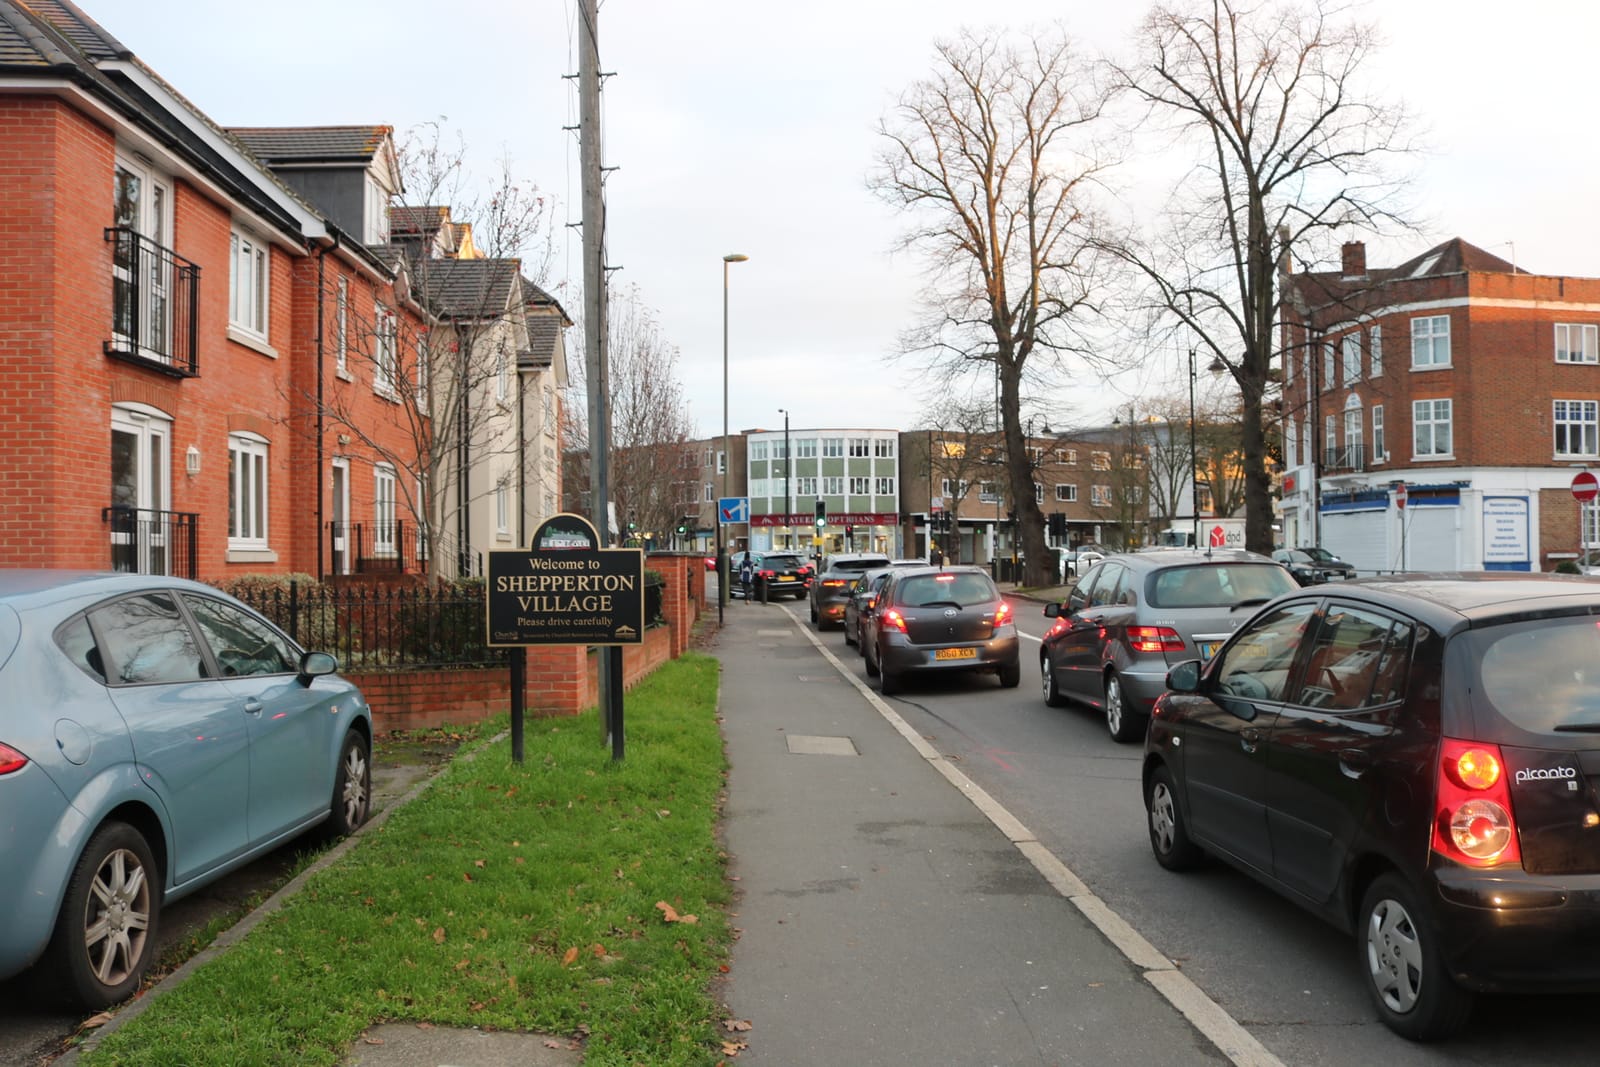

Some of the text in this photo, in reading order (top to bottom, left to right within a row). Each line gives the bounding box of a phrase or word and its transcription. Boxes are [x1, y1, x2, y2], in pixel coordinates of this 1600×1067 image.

[1226, 530, 1241, 545] dpd
[529, 558, 601, 570] Welcome to
[497, 575, 635, 592] SHEPPERTON
[517, 595, 613, 612] VILLAGE
[517, 616, 613, 627] Please drive carefully
[1515, 766, 1576, 785] picanto
